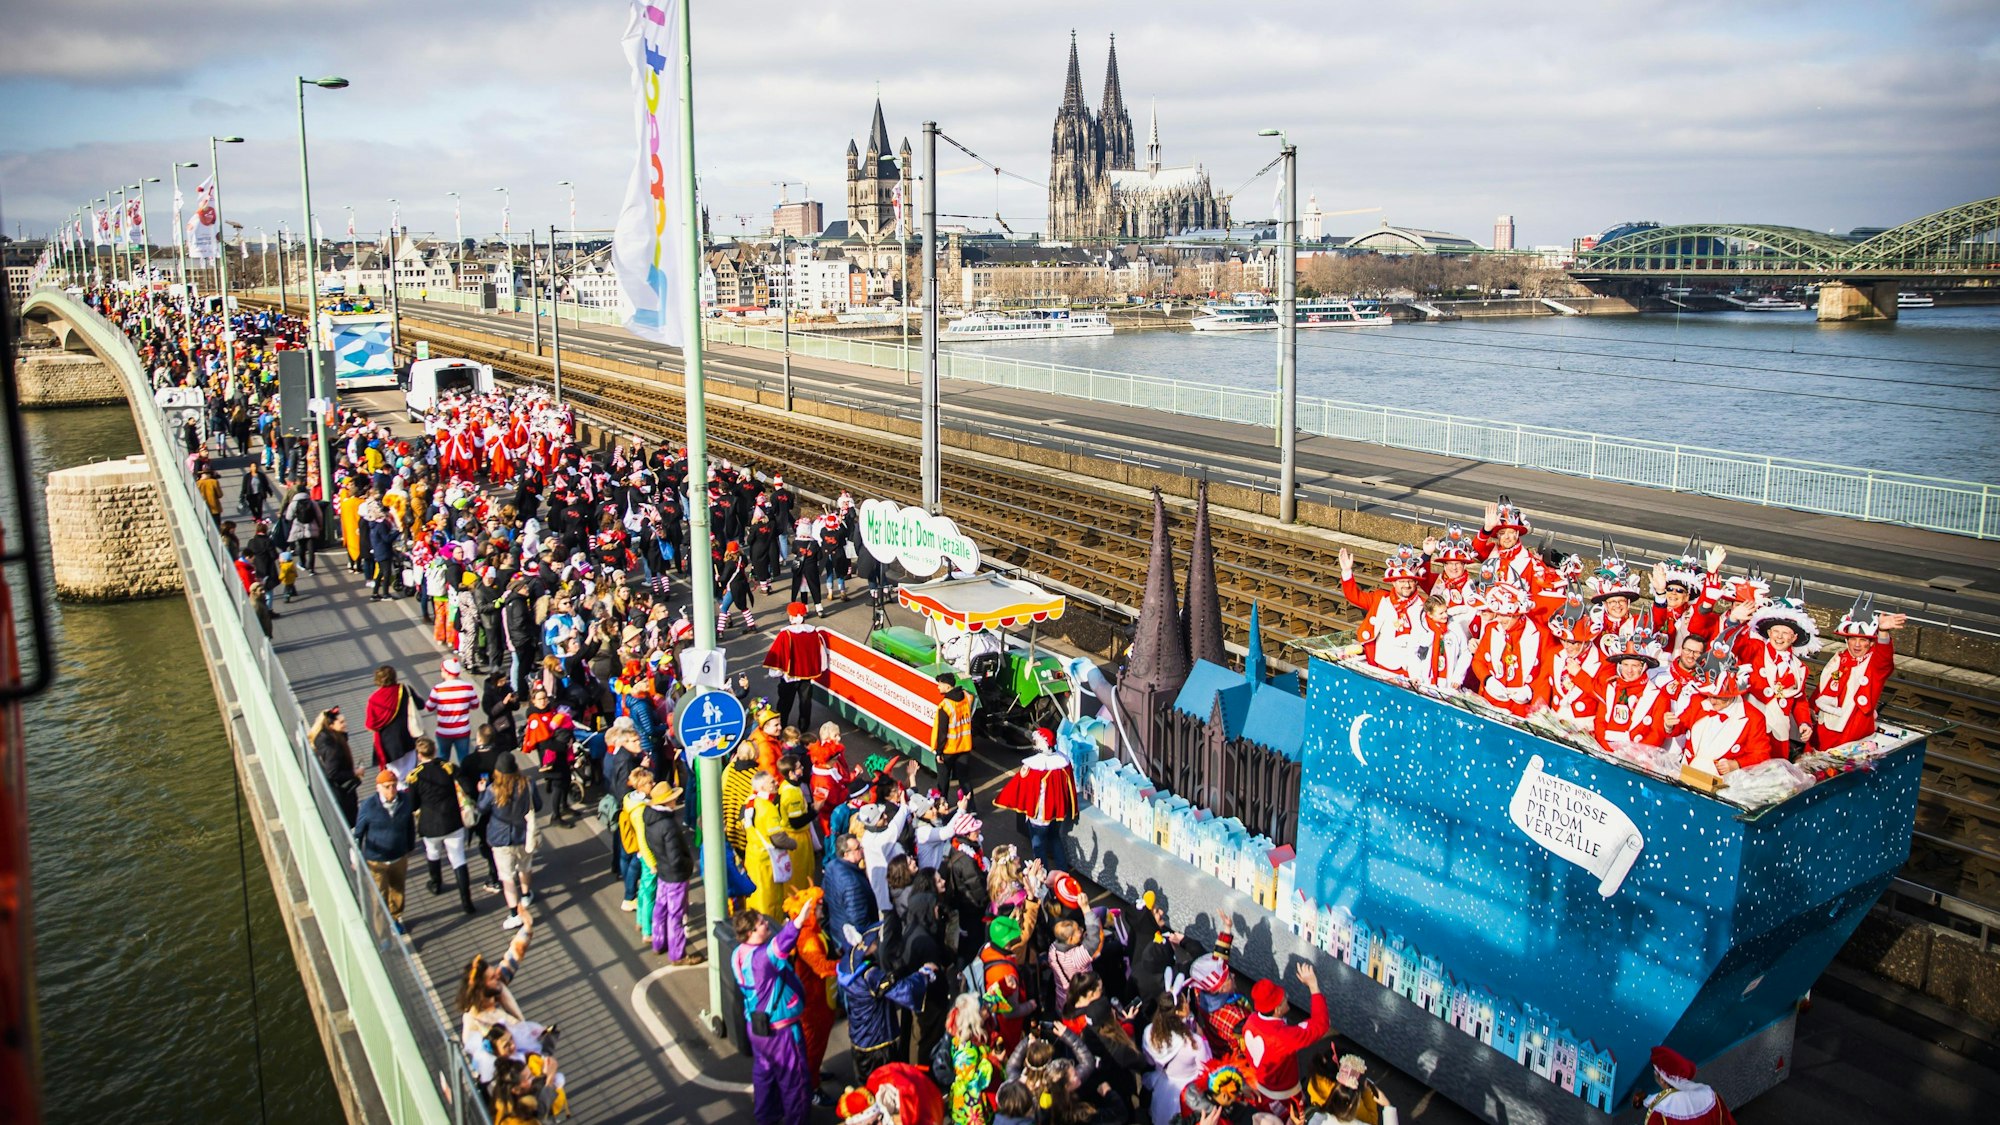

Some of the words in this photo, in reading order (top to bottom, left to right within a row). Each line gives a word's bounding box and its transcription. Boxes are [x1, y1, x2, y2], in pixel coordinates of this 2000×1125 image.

[867, 510, 882, 545] Mer
[884, 510, 899, 546] lose
[902, 517, 913, 547] d'r
[916, 520, 935, 548] Dom
[937, 534, 971, 560] verzälle
[702, 660, 711, 674] 6
[884, 683, 911, 707] Karnevals
[911, 700, 922, 713] von
[923, 705, 936, 720] 182
[1529, 785, 1560, 807] MER
[1567, 797, 1608, 825] LOSSE
[1537, 776, 1571, 793] MOTTO
[1575, 788, 1592, 801] 1980
[1527, 799, 1546, 819] D'R
[1552, 809, 1582, 833] DOM
[1525, 814, 1601, 858] VERZÄLLE
